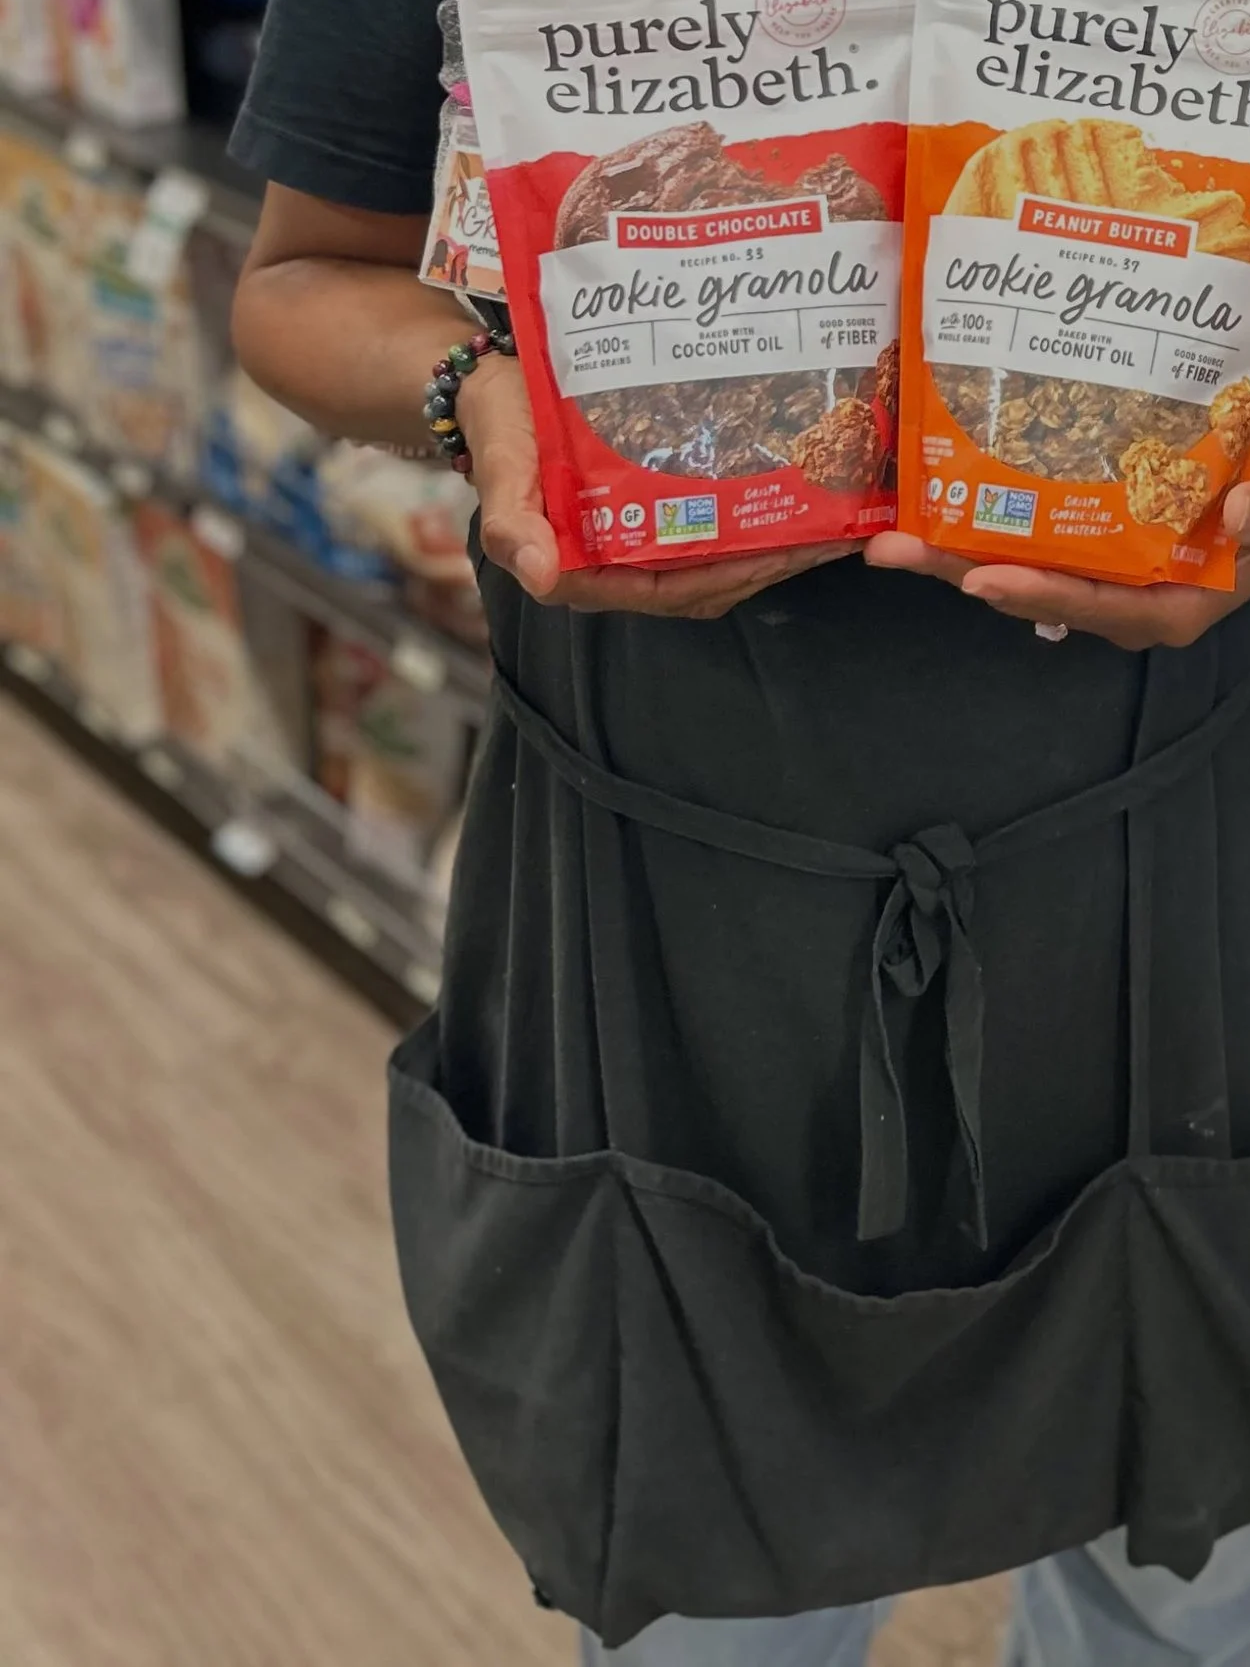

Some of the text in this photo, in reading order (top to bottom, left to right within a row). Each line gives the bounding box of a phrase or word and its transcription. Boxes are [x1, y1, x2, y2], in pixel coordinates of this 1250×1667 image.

[546, 44, 879, 115] elizabeth.
[626, 209, 811, 241] DOUBLE CHOCOLATE
[1031, 209, 1178, 248] PEANUT BUTTER
[572, 251, 879, 326] cookie granola
[946, 254, 1242, 332] cookie granola
[819, 318, 876, 328] GOOD SOURCE
[672, 336, 784, 359] COCONUT OIL
[820, 331, 877, 348] of FIBER
[1029, 336, 1135, 367] COCONUT OIL
